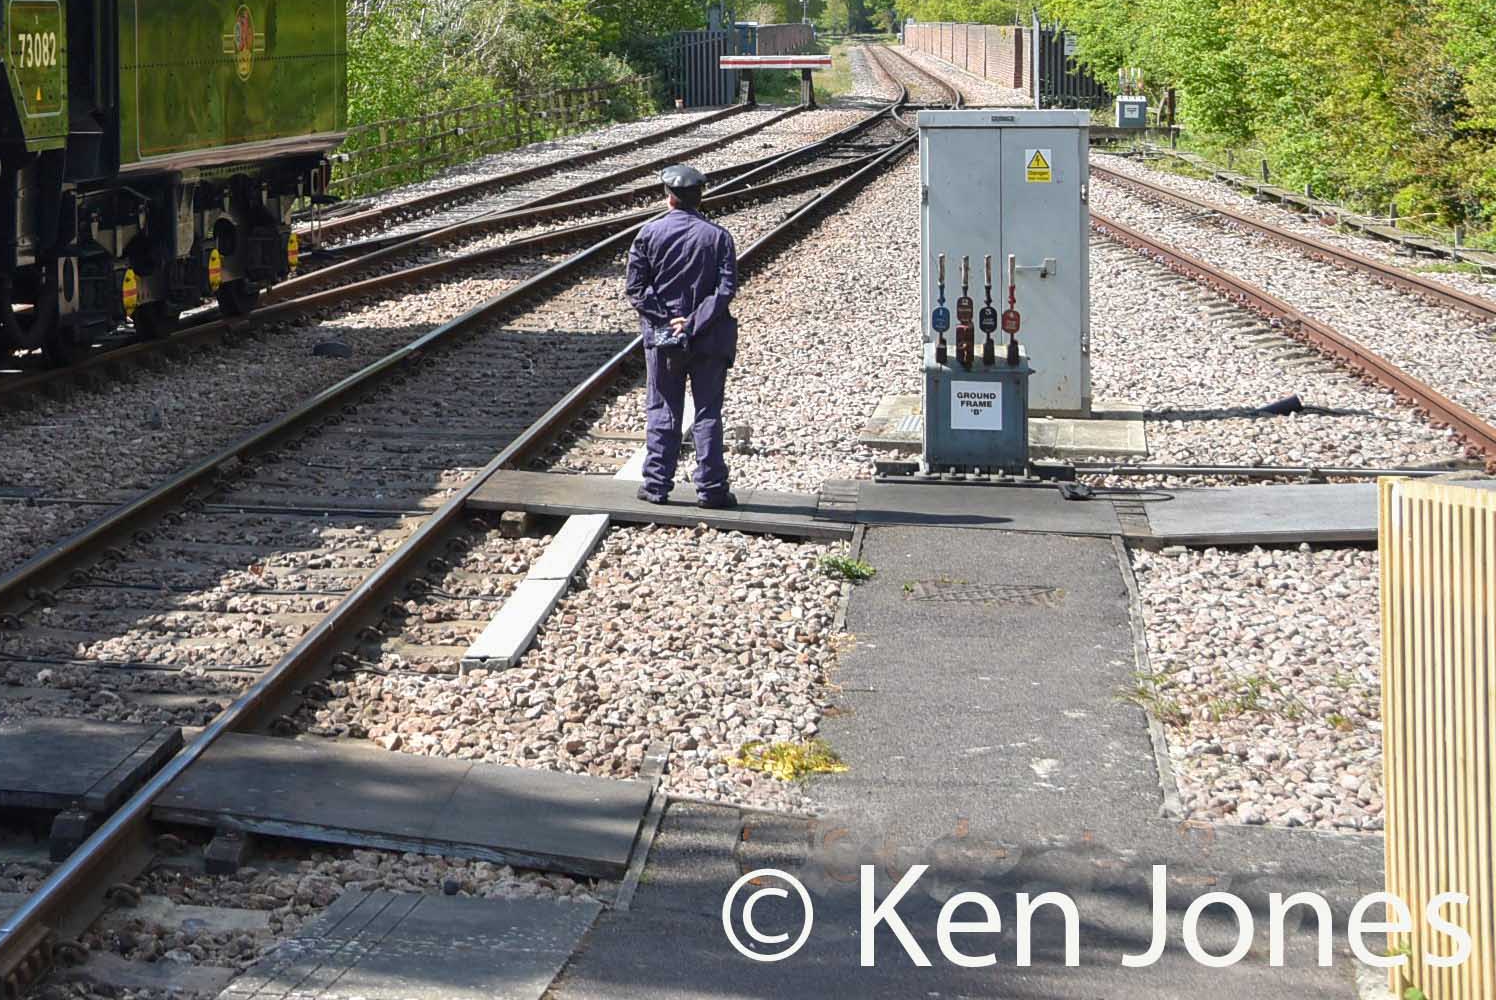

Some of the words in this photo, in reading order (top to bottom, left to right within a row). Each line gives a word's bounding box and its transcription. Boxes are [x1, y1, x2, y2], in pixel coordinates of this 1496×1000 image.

[18, 32, 57, 68] 73082
[956, 391, 997, 400] GROUND
[960, 399, 993, 408] FRAME
